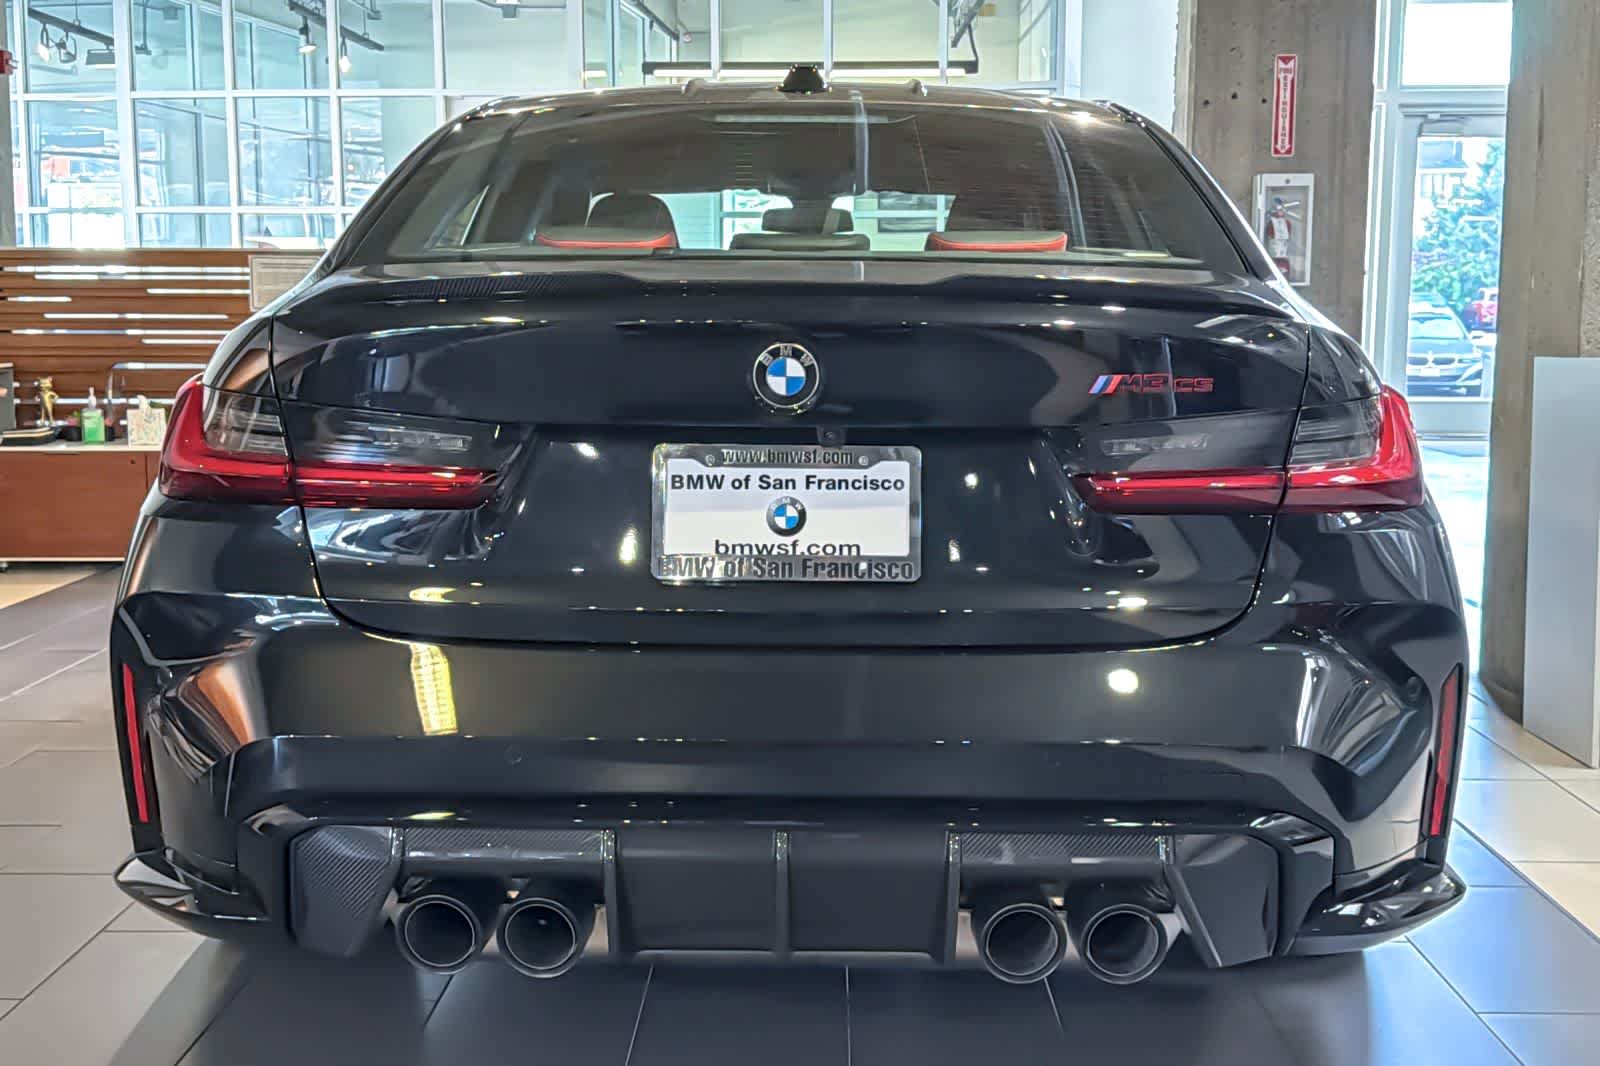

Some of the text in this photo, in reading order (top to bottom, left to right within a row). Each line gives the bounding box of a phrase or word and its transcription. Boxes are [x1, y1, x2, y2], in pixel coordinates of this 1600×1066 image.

[1173, 377, 1214, 393] CS
[721, 448, 853, 465] www.bmwsf.com
[670, 474, 905, 491] BMW of San Francisco
[714, 539, 861, 555] bmwsf.com
[658, 556, 913, 580] BMW of San Francisco
